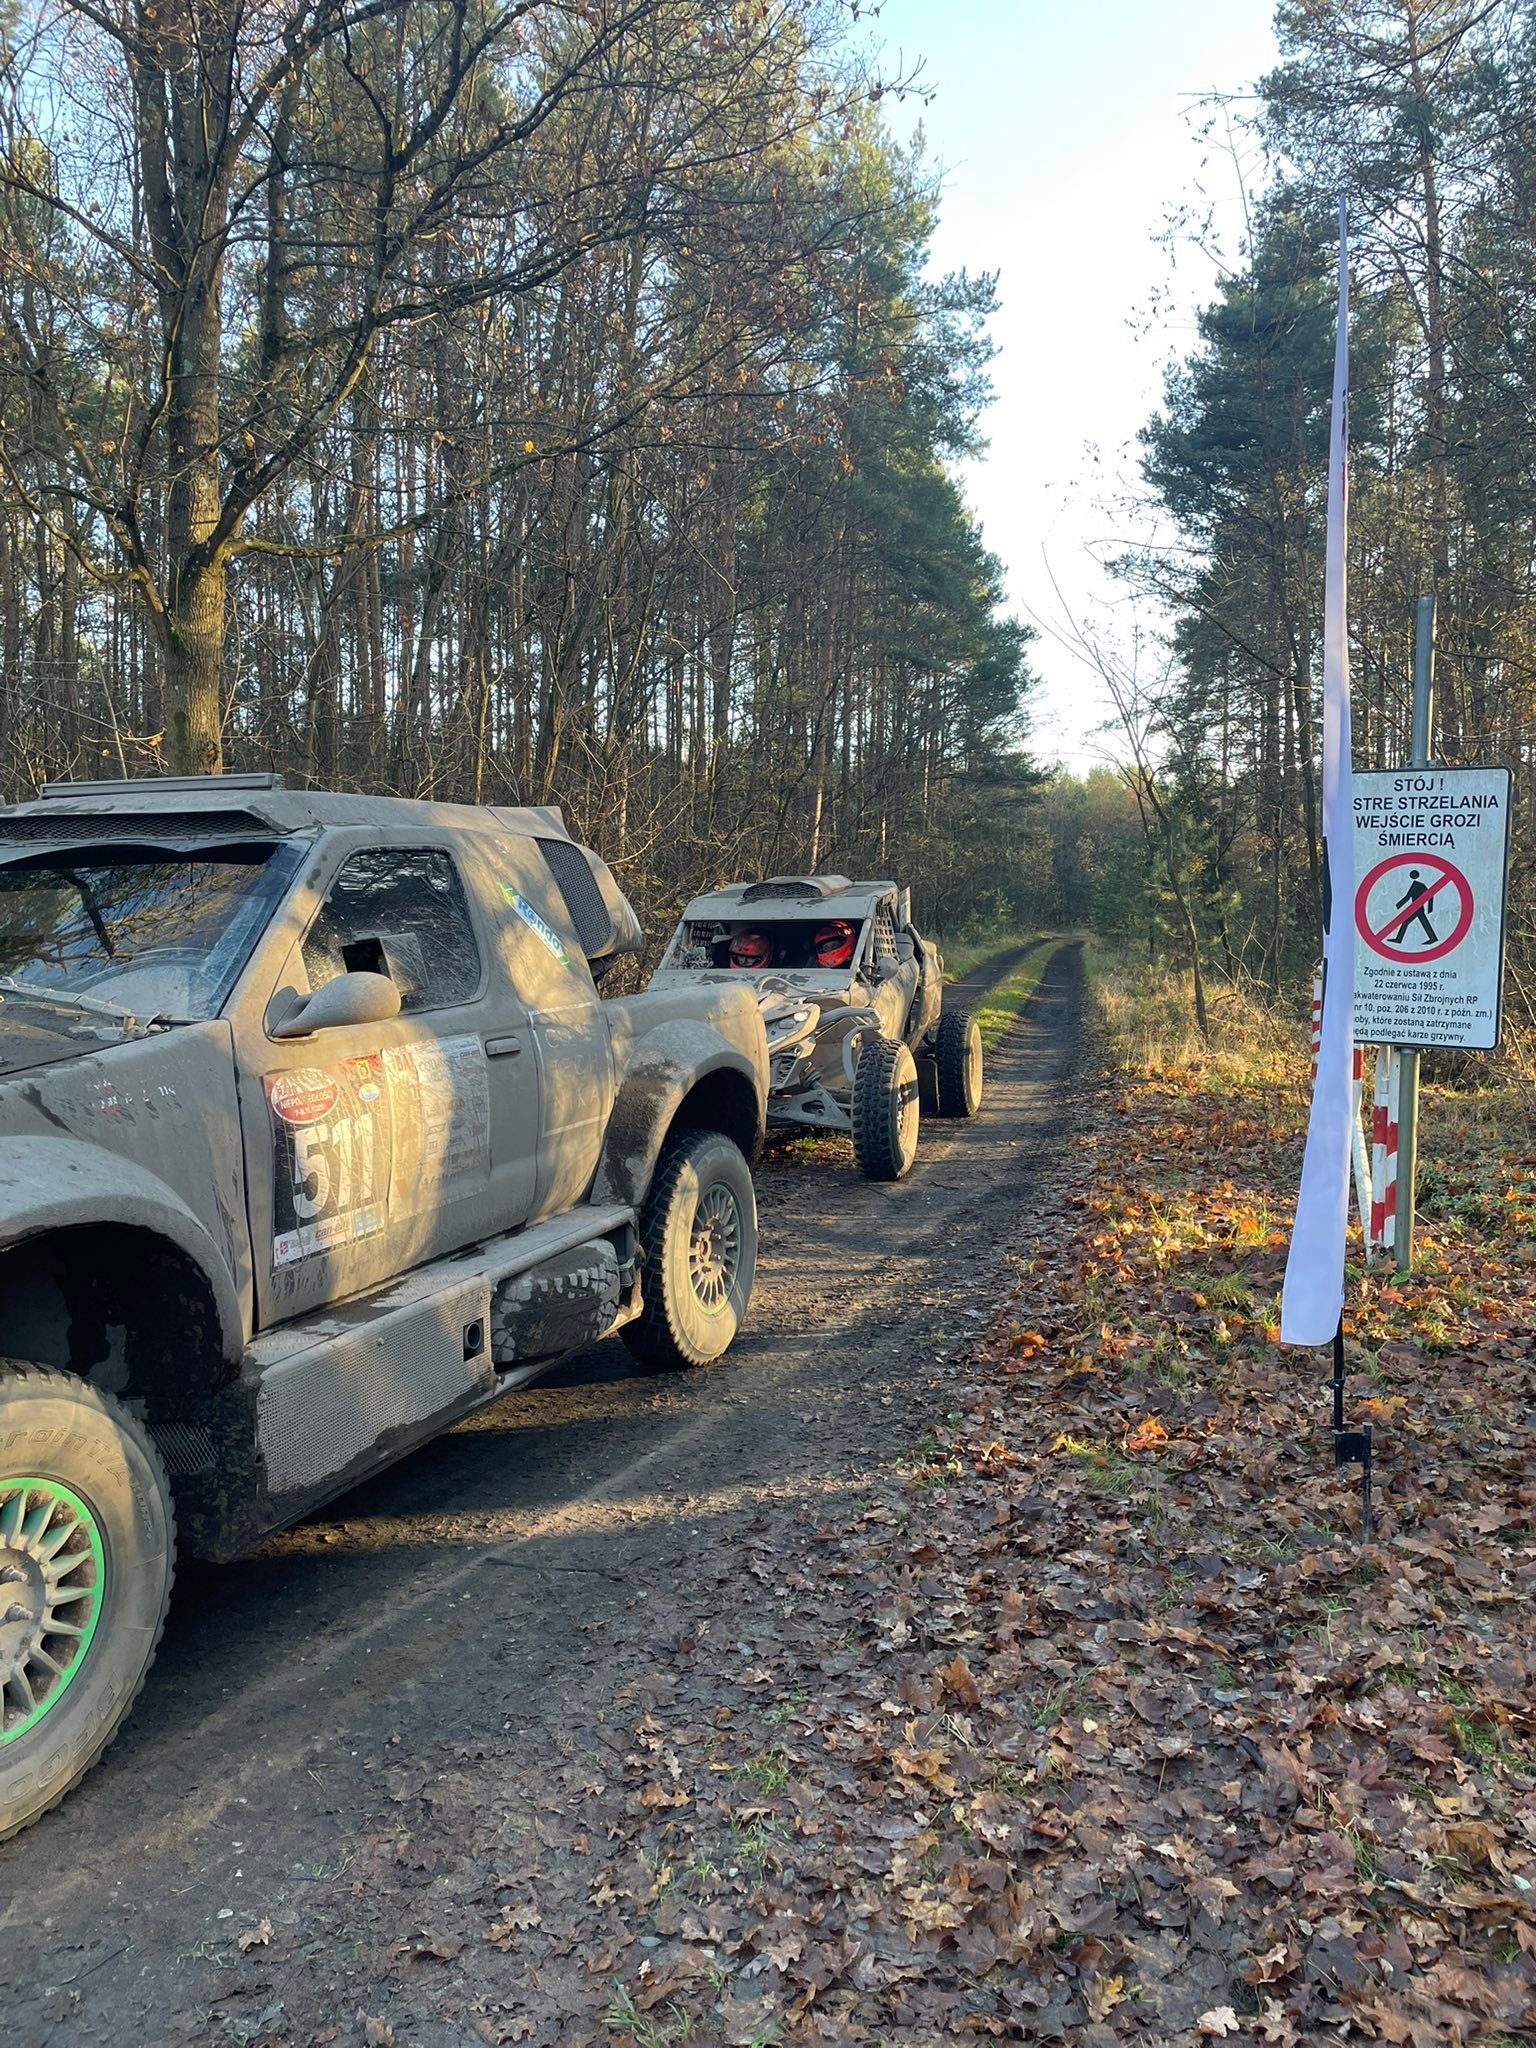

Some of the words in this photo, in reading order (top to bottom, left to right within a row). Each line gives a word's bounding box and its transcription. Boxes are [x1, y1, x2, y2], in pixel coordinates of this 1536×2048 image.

[1394, 775, 1434, 792] STÓJ
[1353, 797, 1393, 810] STRE
[1398, 795, 1499, 810] STRZELANIA
[1356, 812, 1425, 828] WEJŚCIE
[1430, 813, 1481, 828] GROZI
[1378, 830, 1456, 849] ŚMIERCIĄ
[1363, 967, 1395, 978] Zgodnie
[1396, 969, 1402, 977] z
[1403, 969, 1432, 980] ustawą
[1433, 971, 1438, 979] z
[1439, 969, 1457, 979] dnia
[1374, 979, 1383, 988] 22
[1385, 981, 1417, 990] czerwca
[1419, 981, 1437, 991] 1995
[1439, 983, 1445, 991] r.
[1354, 991, 1410, 1002] akwaterowaniu
[1411, 993, 1422, 1002] Sił
[1423, 994, 1464, 1005] Zbrojnych
[1466, 995, 1478, 1005] RP
[1364, 1003, 1375, 1013] 10,
[1377, 1005, 1393, 1016] poz.
[1395, 1004, 1409, 1014] 206
[1417, 1005, 1435, 1015] 2010
[1437, 1008, 1443, 1016] r.
[1475, 1009, 1492, 1020] zm.)
[1354, 1016, 1370, 1025] oby,
[1372, 1016, 1392, 1025] które
[1393, 1018, 1425, 1029] zostaną
[1426, 1019, 1472, 1030] zatrzymane
[1354, 1027, 1369, 1038] ędą
[1370, 1028, 1406, 1039] podlegać
[1407, 1029, 1429, 1039] karze
[1430, 1032, 1466, 1043] grzywny.
[0, 1427, 87, 1451] rain
